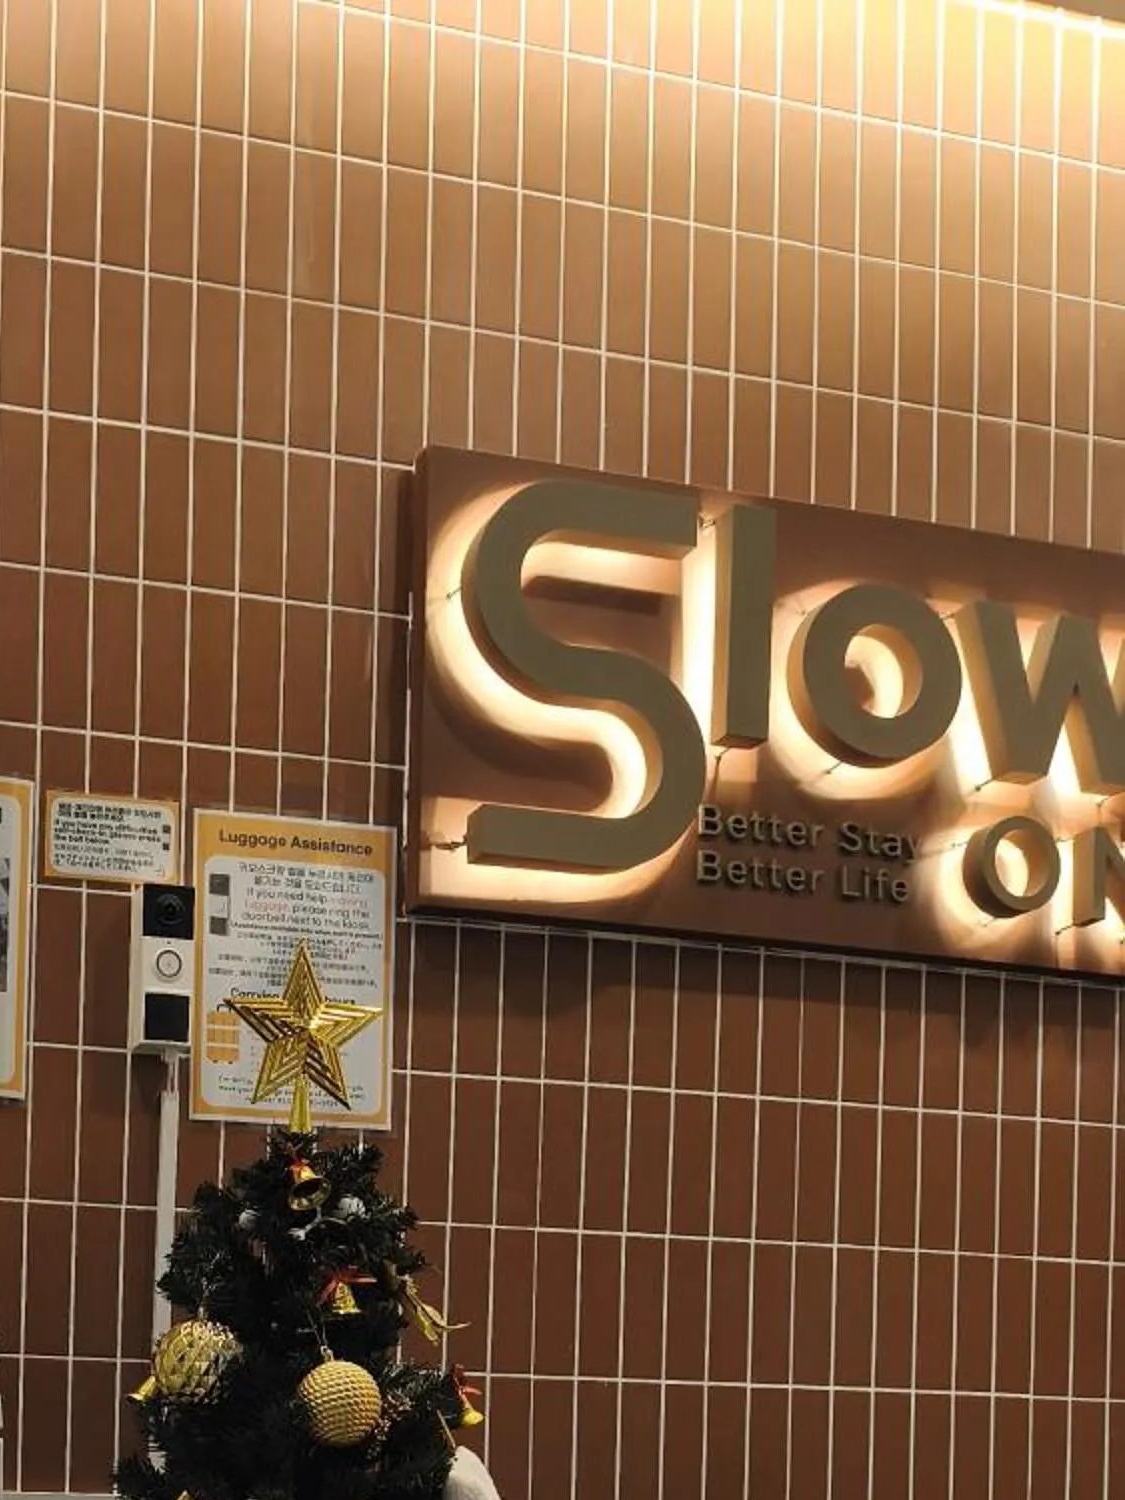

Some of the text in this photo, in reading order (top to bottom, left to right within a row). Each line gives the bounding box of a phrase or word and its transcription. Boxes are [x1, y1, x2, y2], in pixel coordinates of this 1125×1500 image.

[218, 829, 373, 856] Luggage Assistance
[697, 804, 923, 864] Better Stay
[696, 850, 908, 902] Better Life
[256, 888, 274, 900] you
[277, 889, 304, 901] need
[292, 903, 329, 917] please
